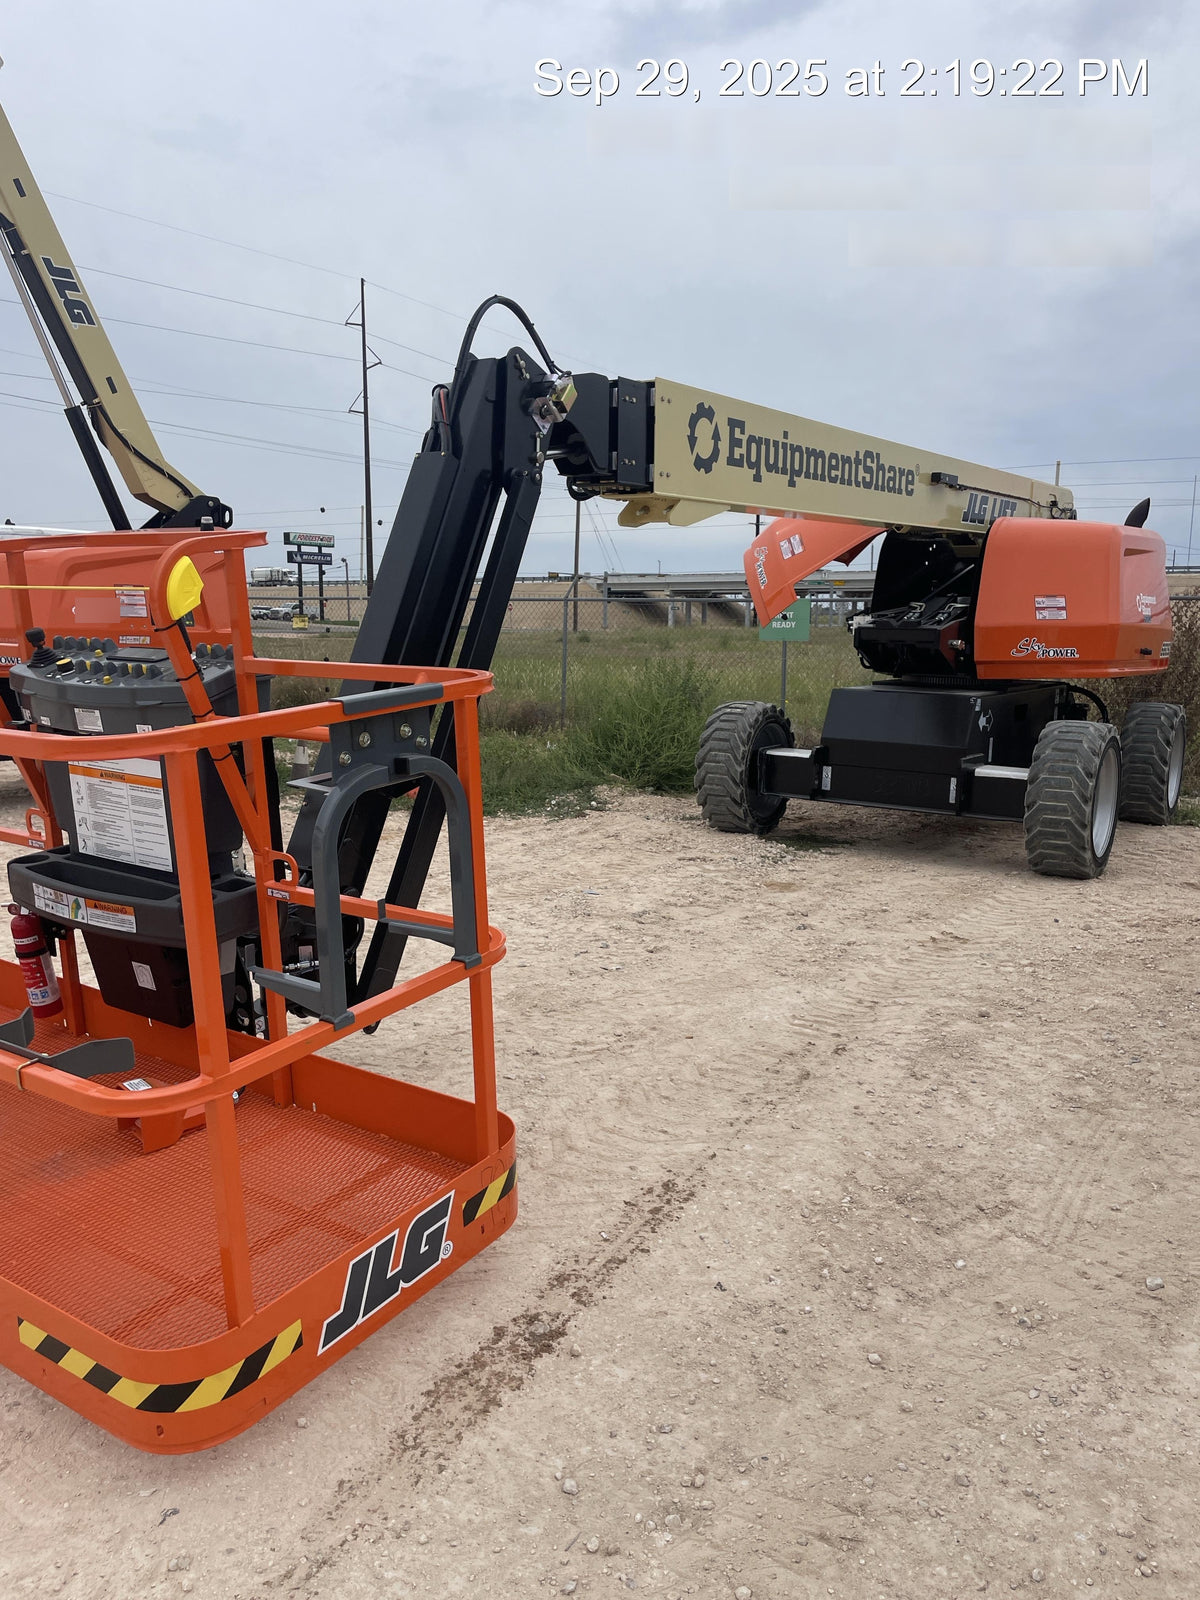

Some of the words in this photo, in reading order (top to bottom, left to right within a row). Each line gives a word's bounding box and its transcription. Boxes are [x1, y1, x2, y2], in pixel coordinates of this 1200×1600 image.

[41, 255, 97, 327] JLG
[726, 417, 915, 497] EquipmentShare
[961, 492, 990, 525] JLG
[989, 497, 1018, 526] LIFT
[771, 621, 796, 629] READY
[98, 903, 128, 915] WARNING
[317, 1189, 455, 1356] JLG
